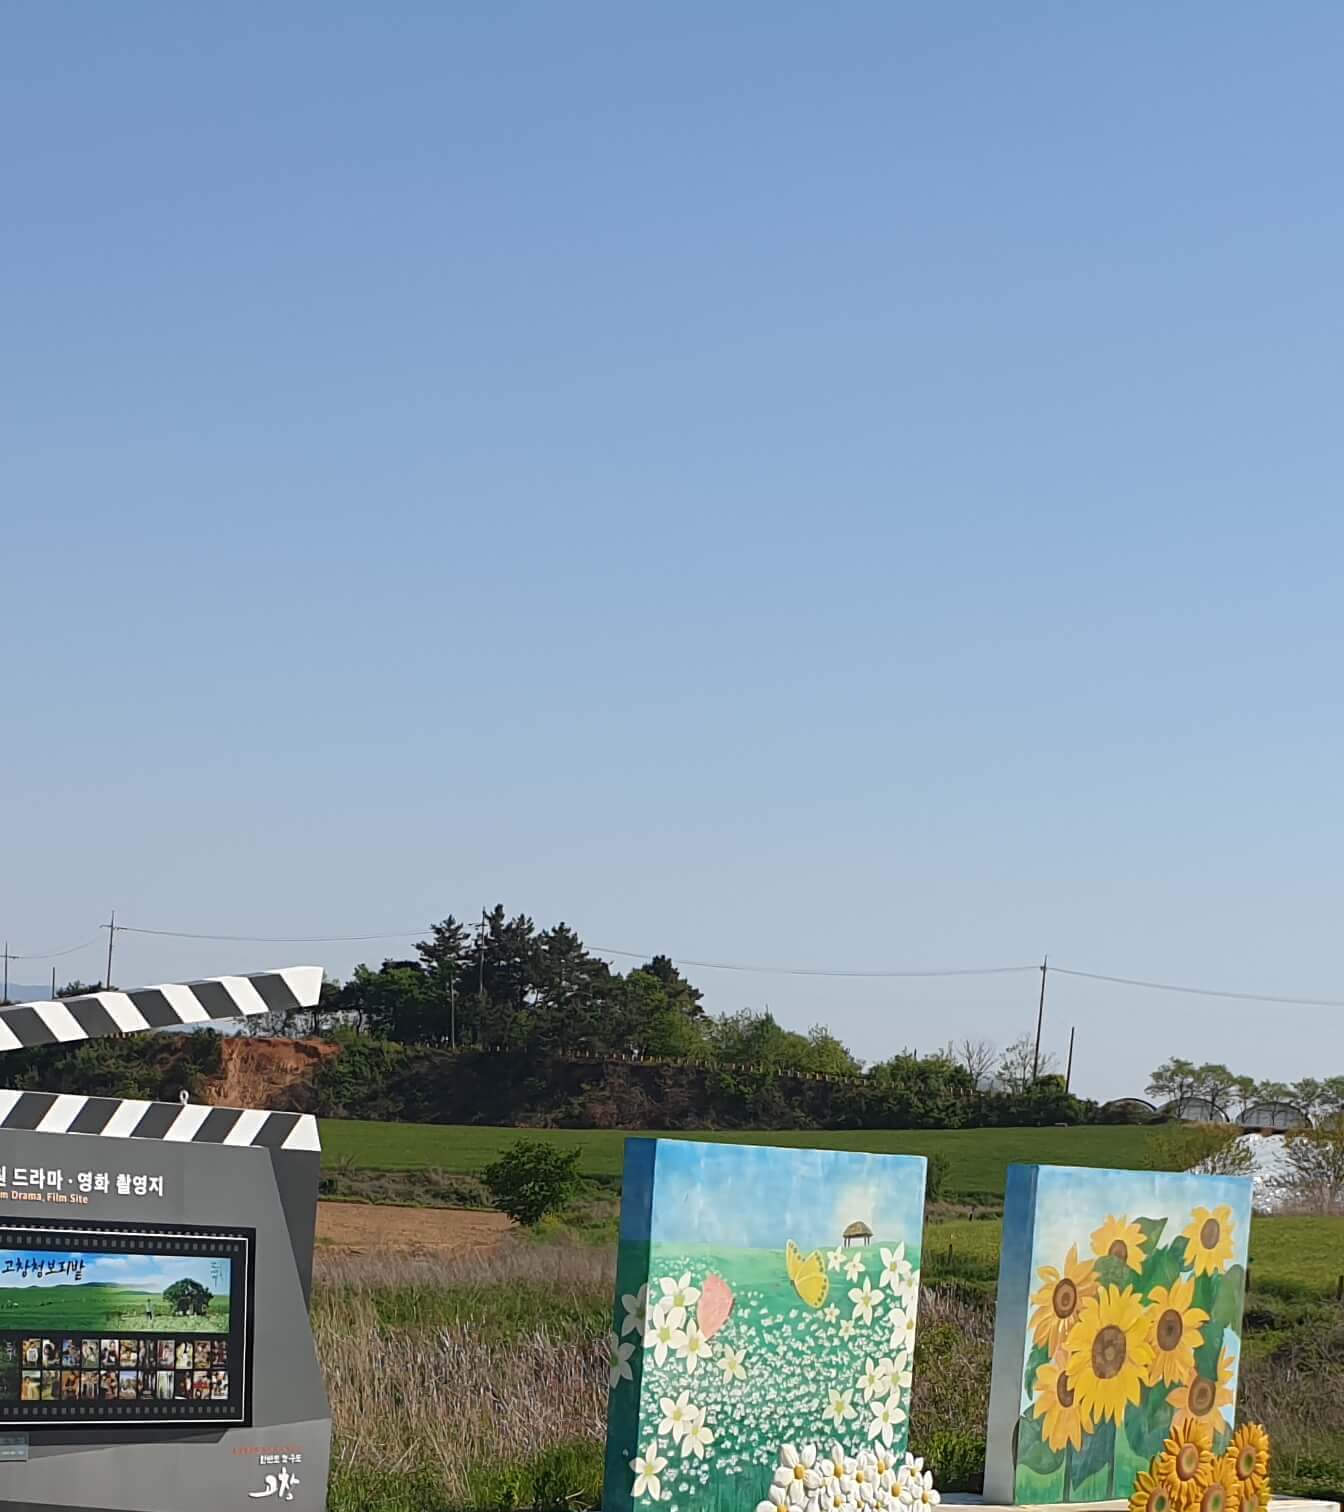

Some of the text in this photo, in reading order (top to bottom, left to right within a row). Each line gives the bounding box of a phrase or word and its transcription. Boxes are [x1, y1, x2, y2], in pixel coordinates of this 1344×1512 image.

[116, 1173, 164, 1197] 촬영지
[47, 1192, 67, 1203] Film
[69, 1193, 89, 1204] Site
[248, 1466, 301, 1501] 고창
